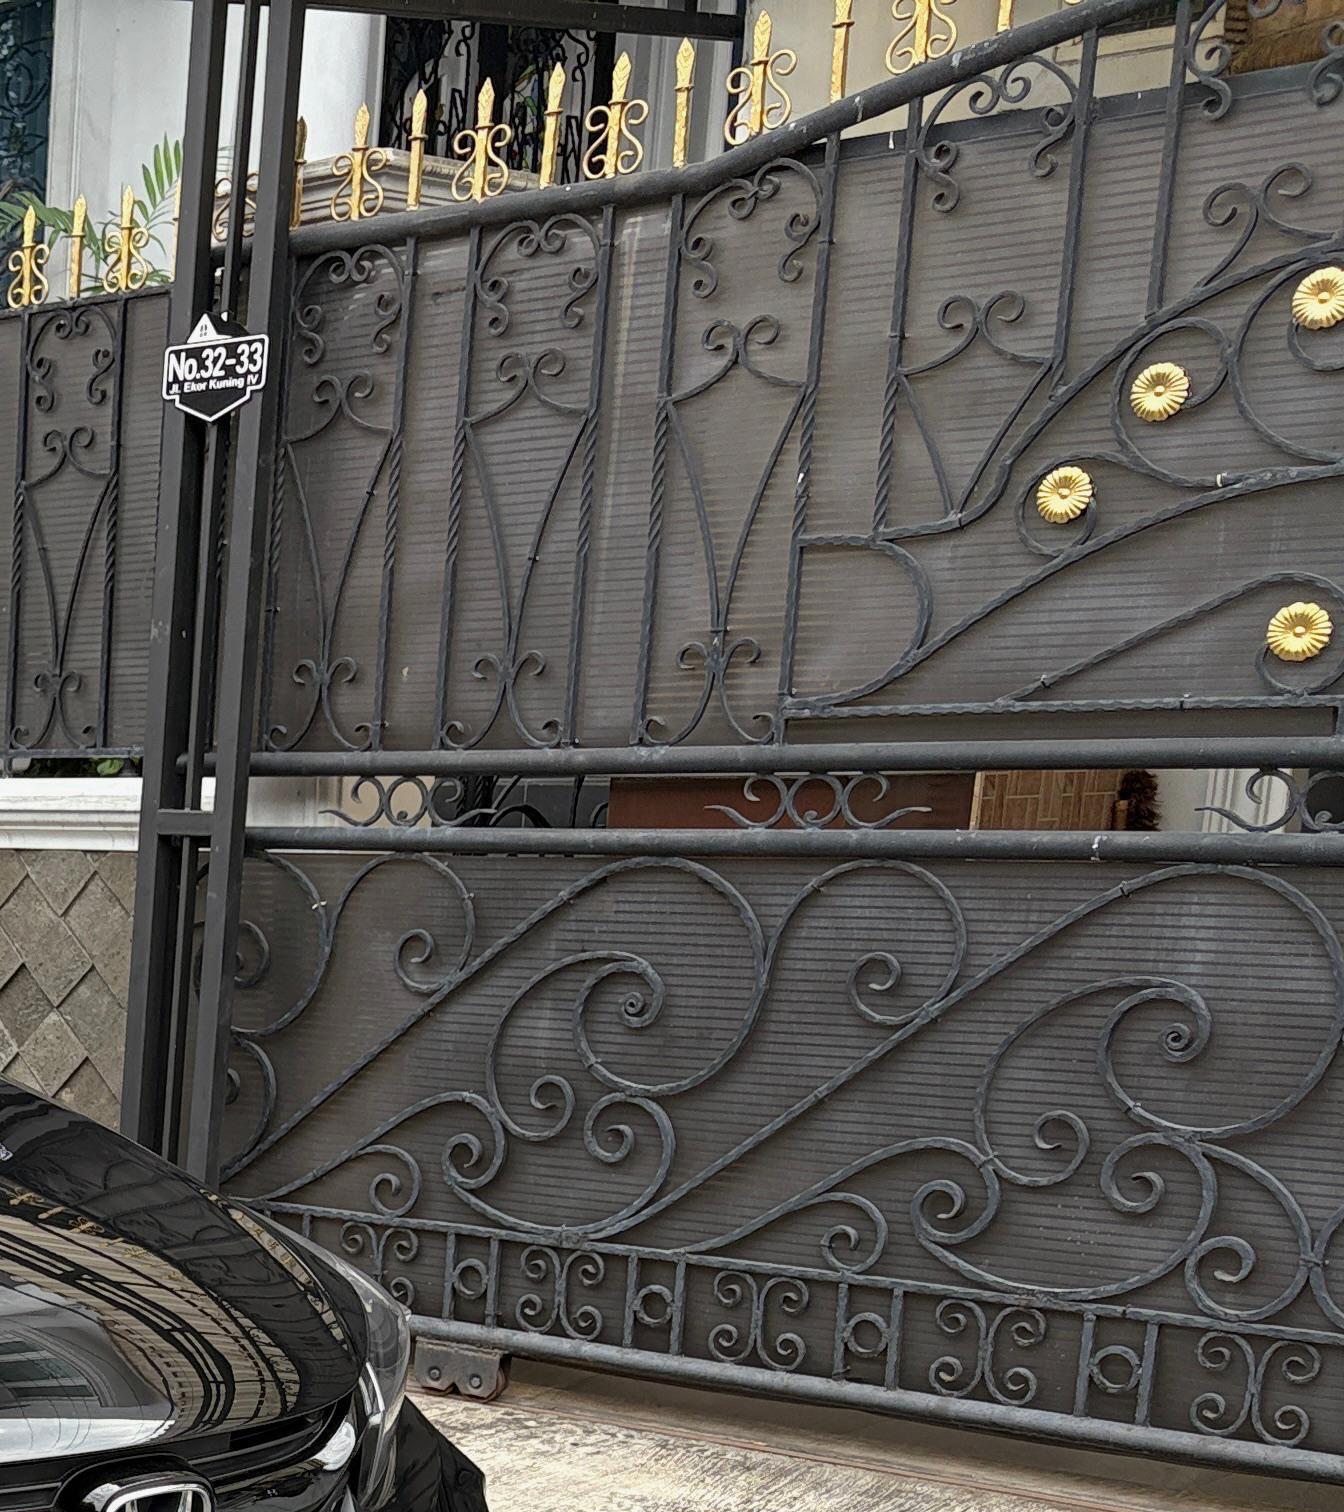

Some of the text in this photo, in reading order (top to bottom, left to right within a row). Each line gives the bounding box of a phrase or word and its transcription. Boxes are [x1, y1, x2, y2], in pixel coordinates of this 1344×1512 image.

[168, 341, 263, 382] No.32-33
[183, 381, 207, 393] Ekor
[209, 376, 245, 390] Kuning
[246, 373, 259, 385] IV
